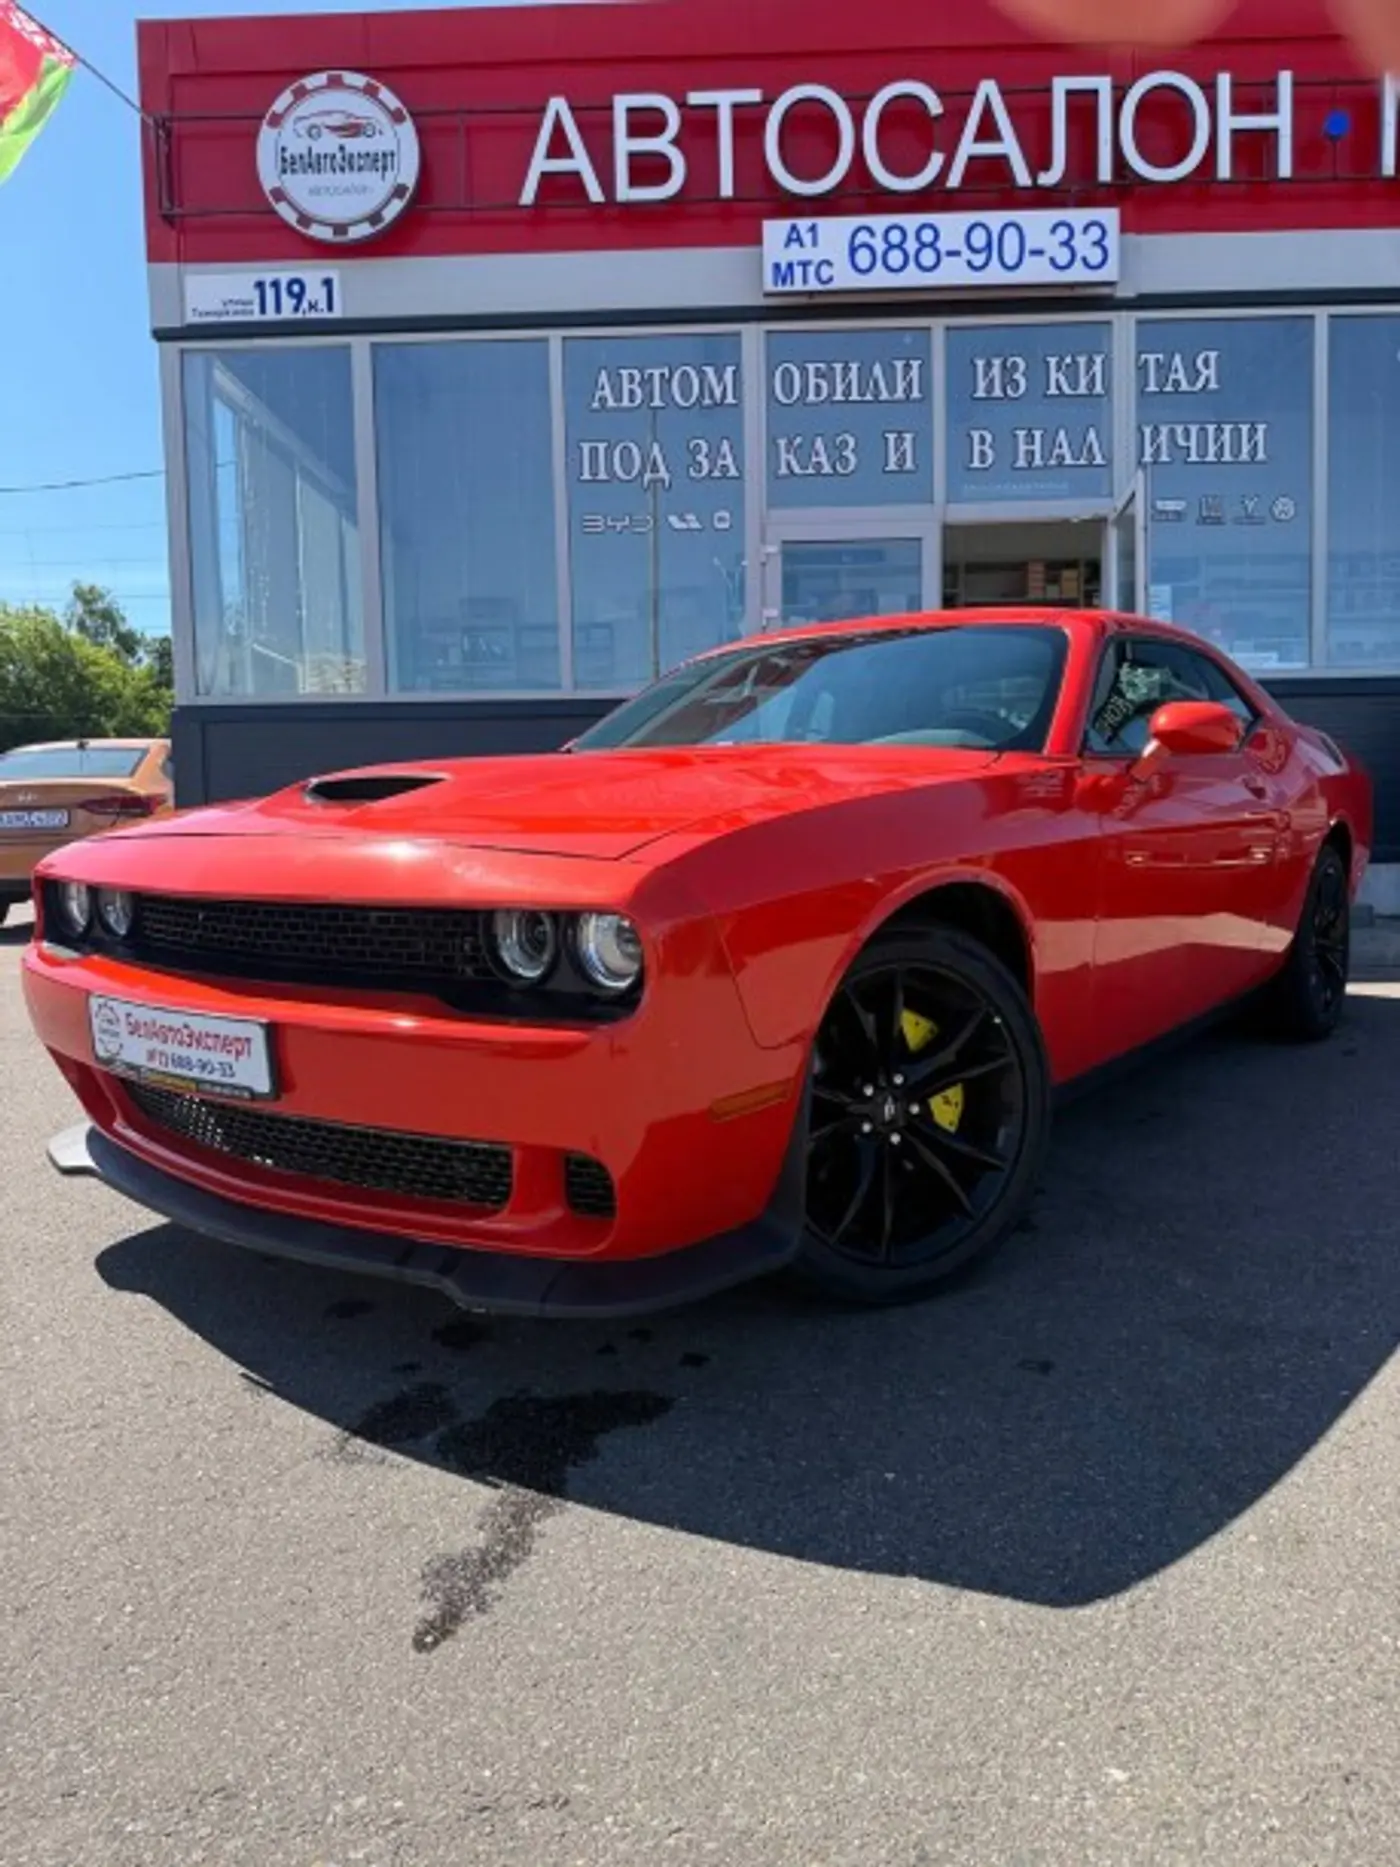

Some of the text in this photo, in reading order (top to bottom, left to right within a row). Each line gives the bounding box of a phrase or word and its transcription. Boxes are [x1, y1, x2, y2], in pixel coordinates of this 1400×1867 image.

[518, 69, 1294, 208] АВТОСАЛОН
[772, 259, 834, 288] МТС
[847, 219, 1110, 275] 688-90-33
[972, 355, 1027, 398] ИЗ
[579, 440, 671, 489] ПОД
[884, 432, 917, 472] И
[968, 429, 994, 469] В
